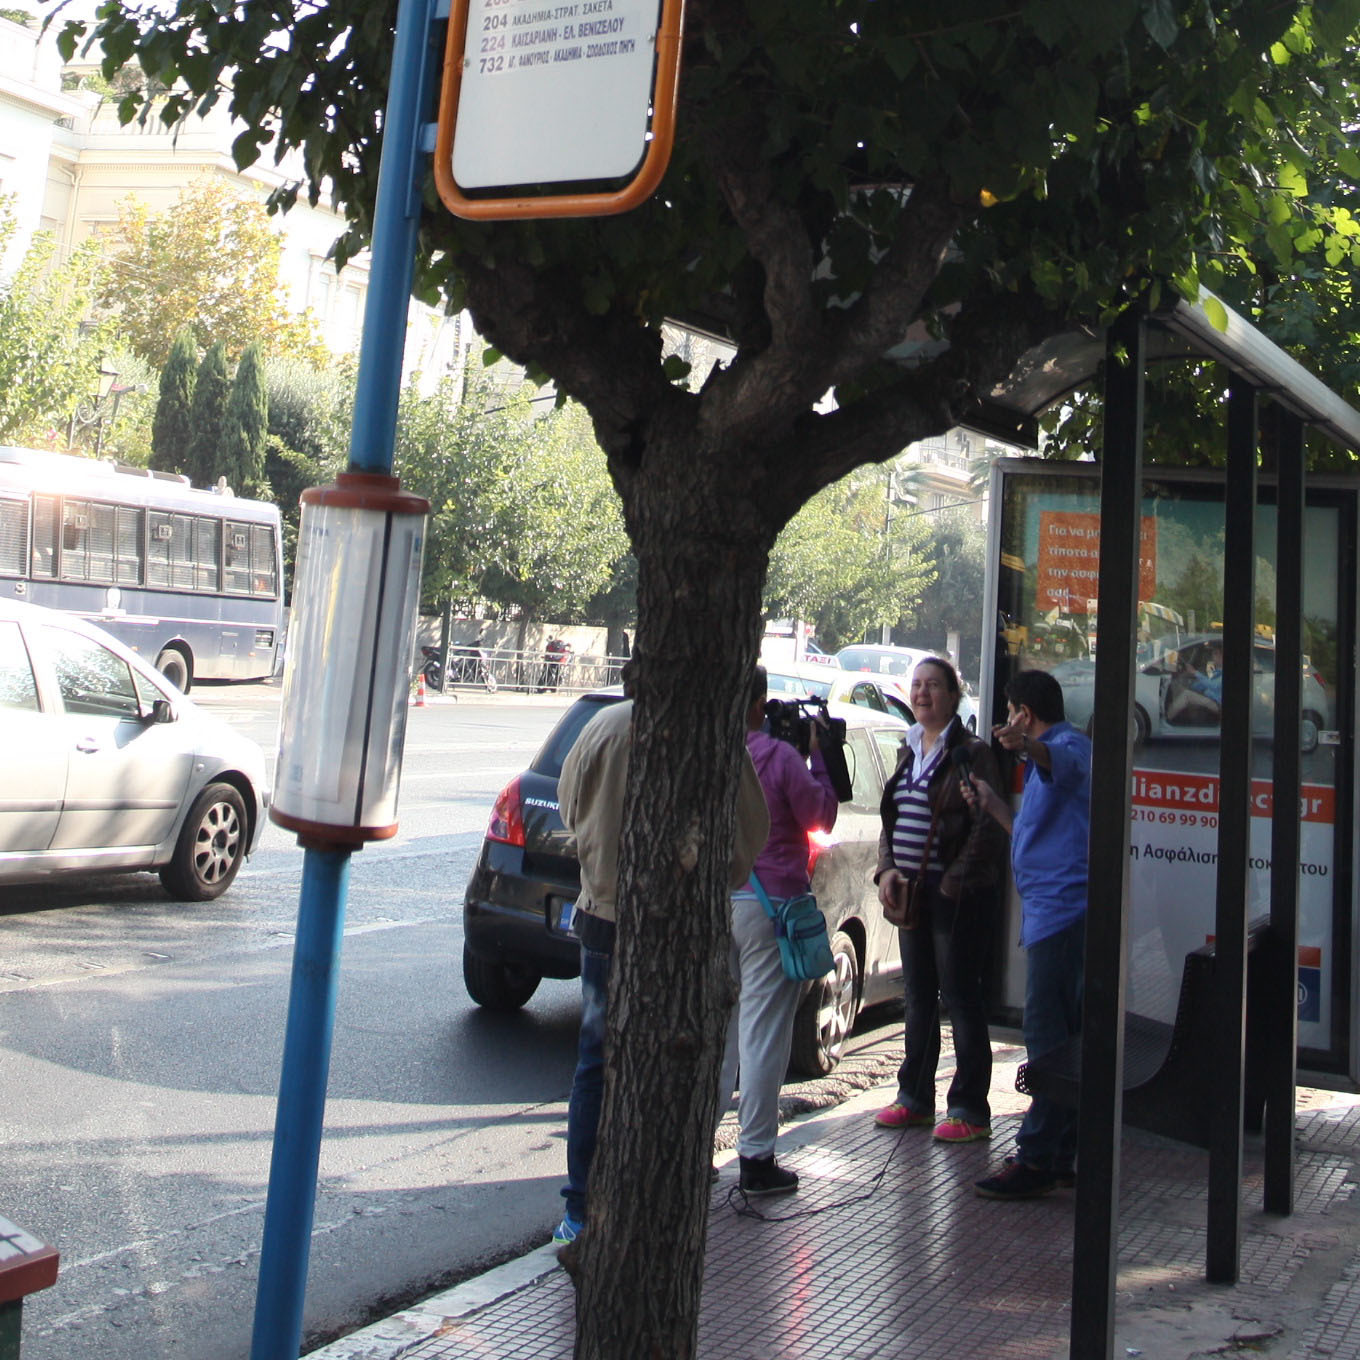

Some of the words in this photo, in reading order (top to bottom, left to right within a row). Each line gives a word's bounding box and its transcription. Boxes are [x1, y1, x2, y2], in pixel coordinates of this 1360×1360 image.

[483, 14, 507, 31] 204
[583, 0, 613, 15] ΣΑΚΕΤΑ
[480, 35, 505, 53] 224
[512, 26, 557, 47] ΚΑΙΣΑΡΙΑΝΗ
[578, 17, 624, 36] ΒΕΝΙΖΕΛΟΥ
[480, 56, 503, 74] 732
[524, 797, 559, 810] SUZUKI
[1159, 812, 1175, 824] 69
[1180, 814, 1196, 826] 99
